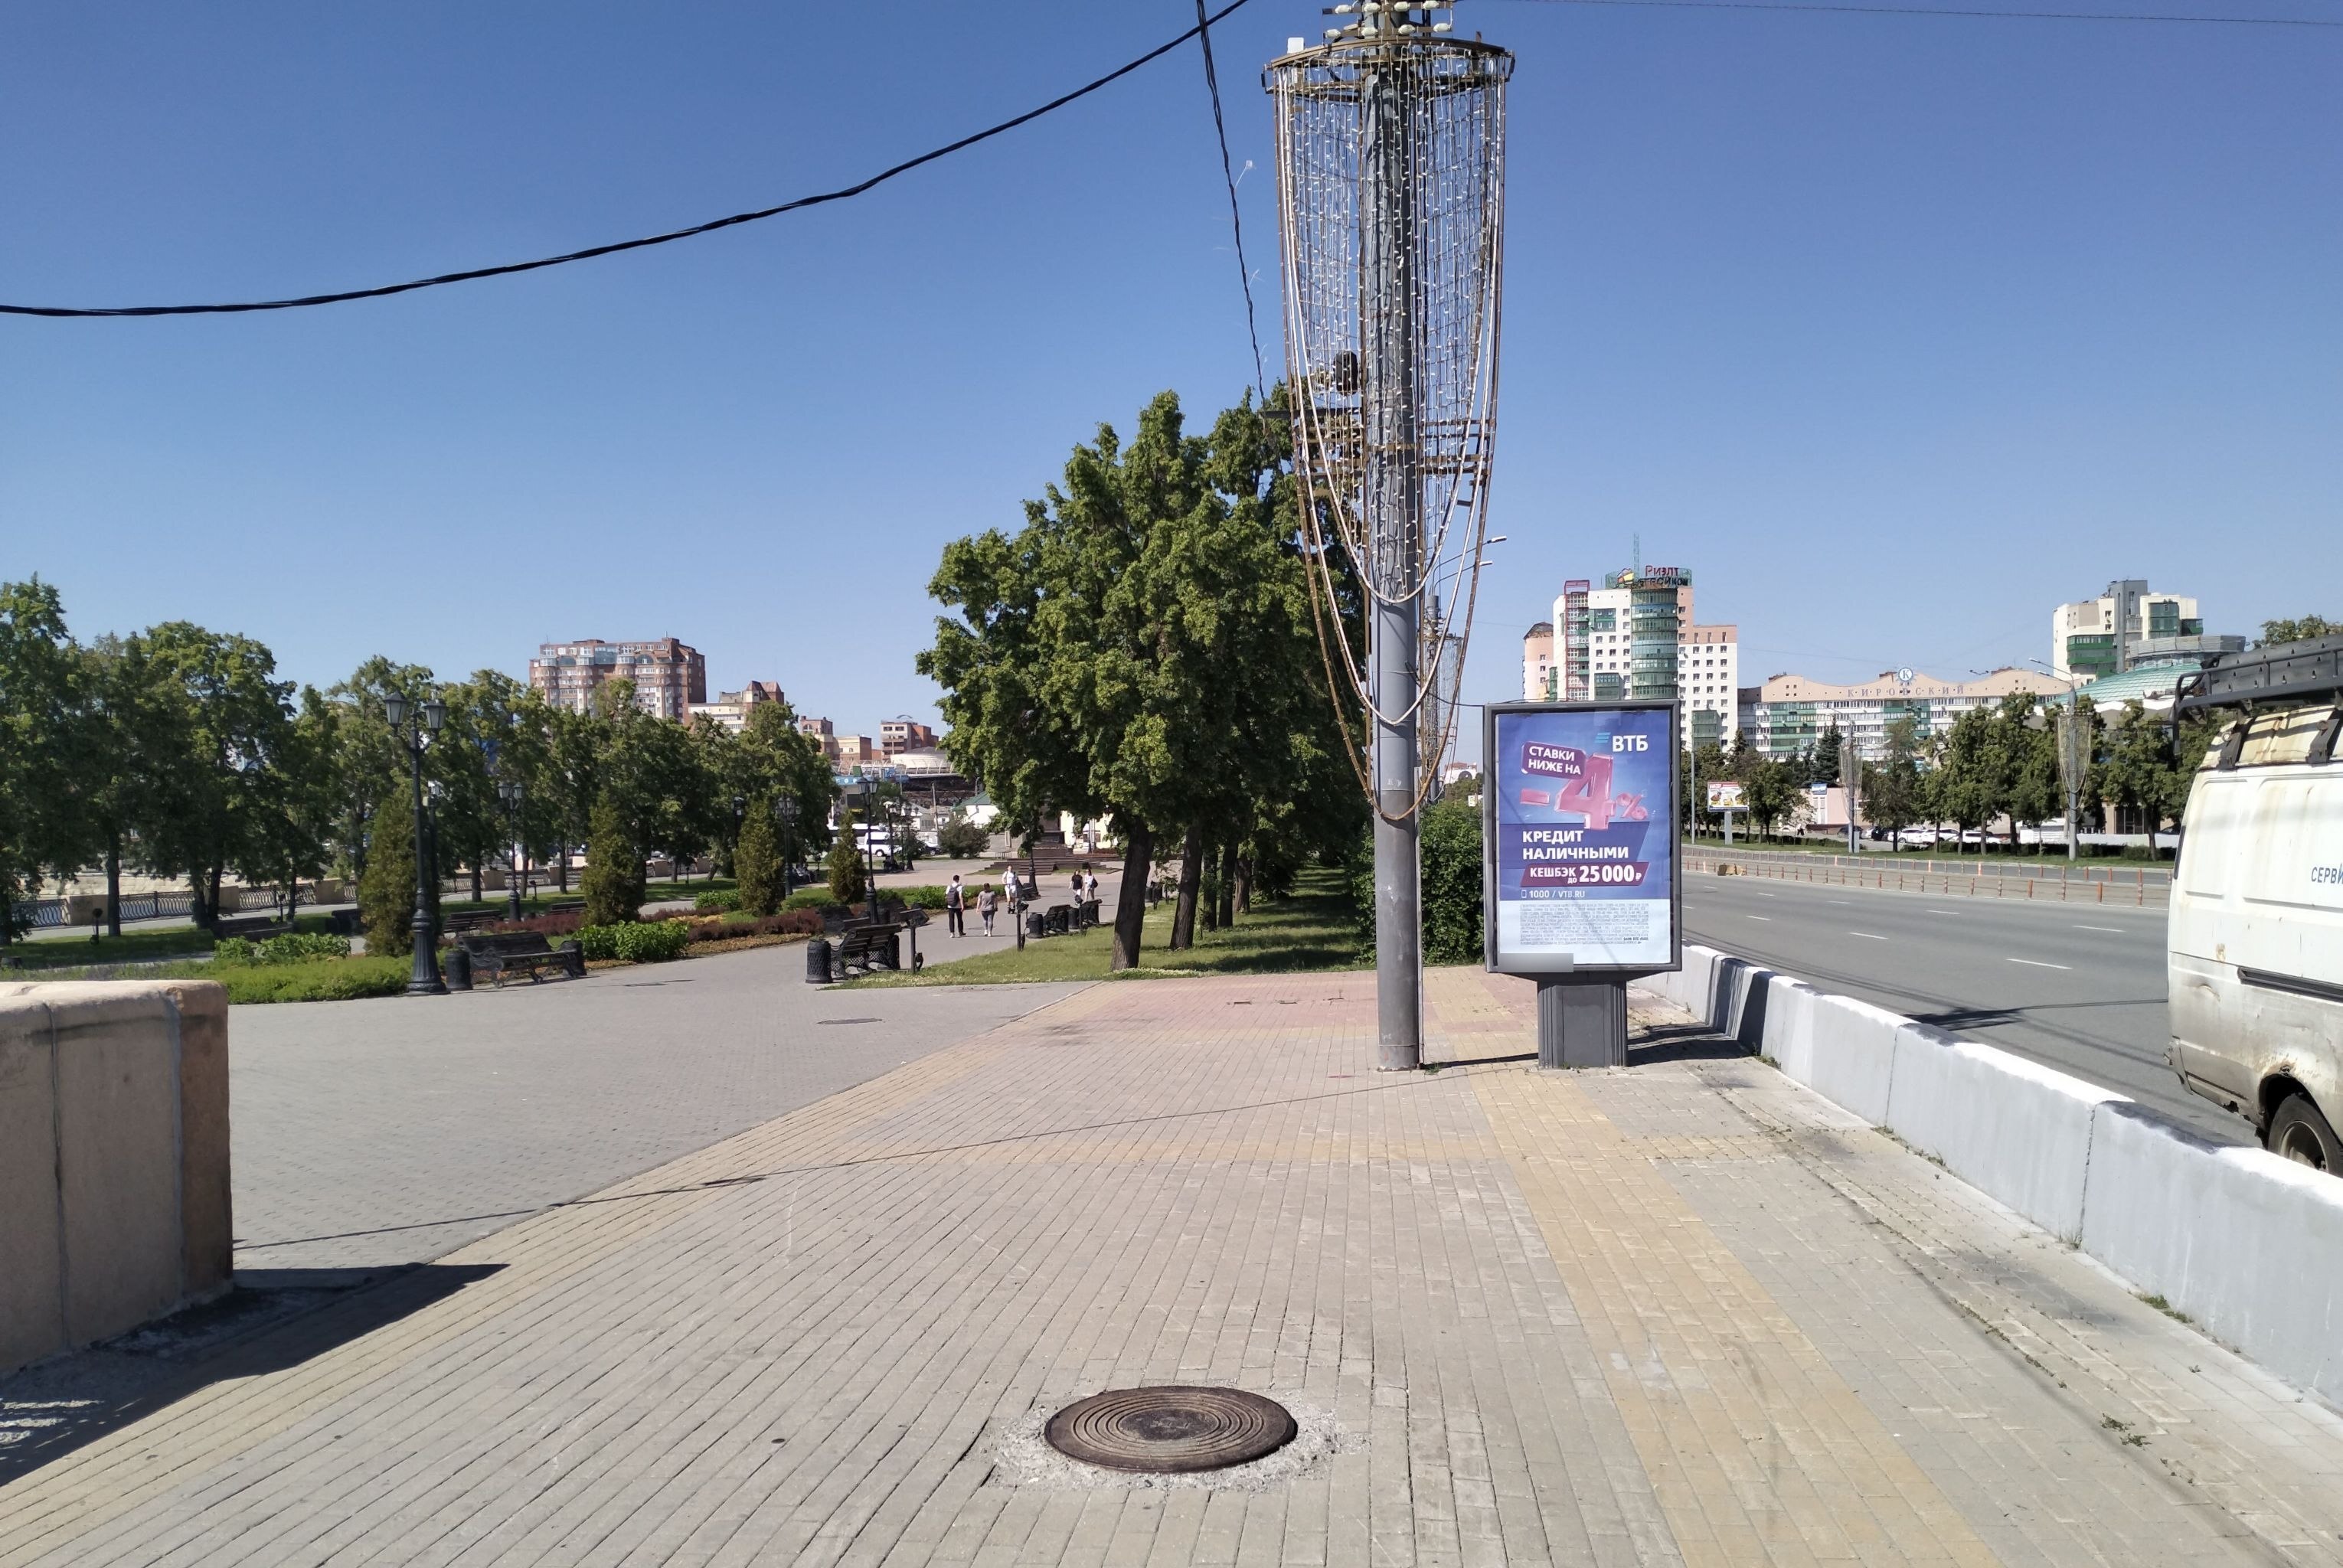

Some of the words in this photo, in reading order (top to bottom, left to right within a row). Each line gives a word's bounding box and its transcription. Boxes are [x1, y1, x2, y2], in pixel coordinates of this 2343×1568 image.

[1613, 735, 1649, 753] ВТБ
[1529, 746, 1575, 762] СТАВКИ
[1528, 758, 1563, 773] НИЖЕ
[1565, 764, 1582, 776] НА
[1522, 830, 1583, 844] КРЕДИТ
[1522, 847, 1629, 860] НАЛИЧНЫМИ
[1530, 867, 1577, 877] КЕШБЭК
[1530, 890, 1550, 898] 1000
